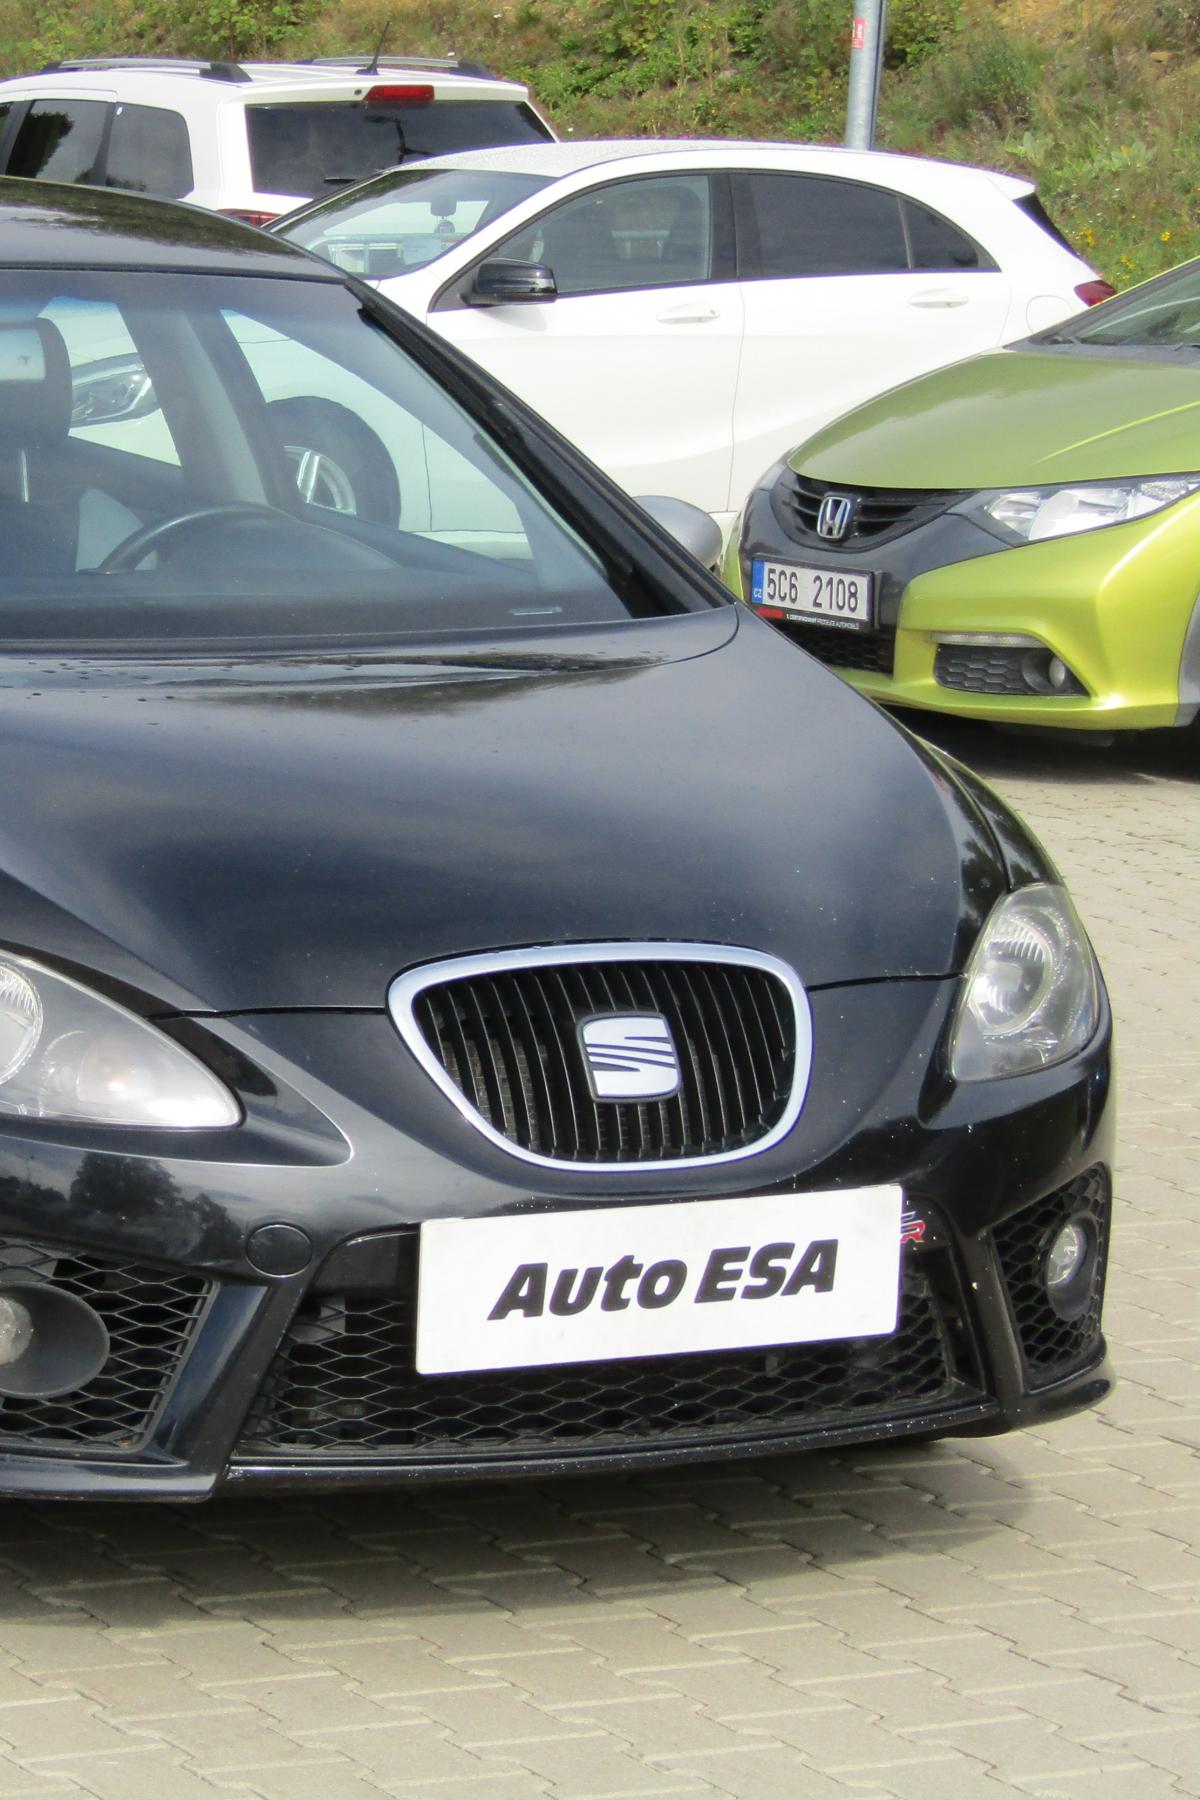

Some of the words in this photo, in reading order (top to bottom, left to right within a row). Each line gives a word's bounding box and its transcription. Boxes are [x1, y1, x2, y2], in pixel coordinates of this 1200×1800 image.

[767, 568, 798, 604] 5C6
[812, 575, 858, 613] 2108
[486, 1254, 688, 1321] Auto
[693, 1238, 839, 1304] ESA
